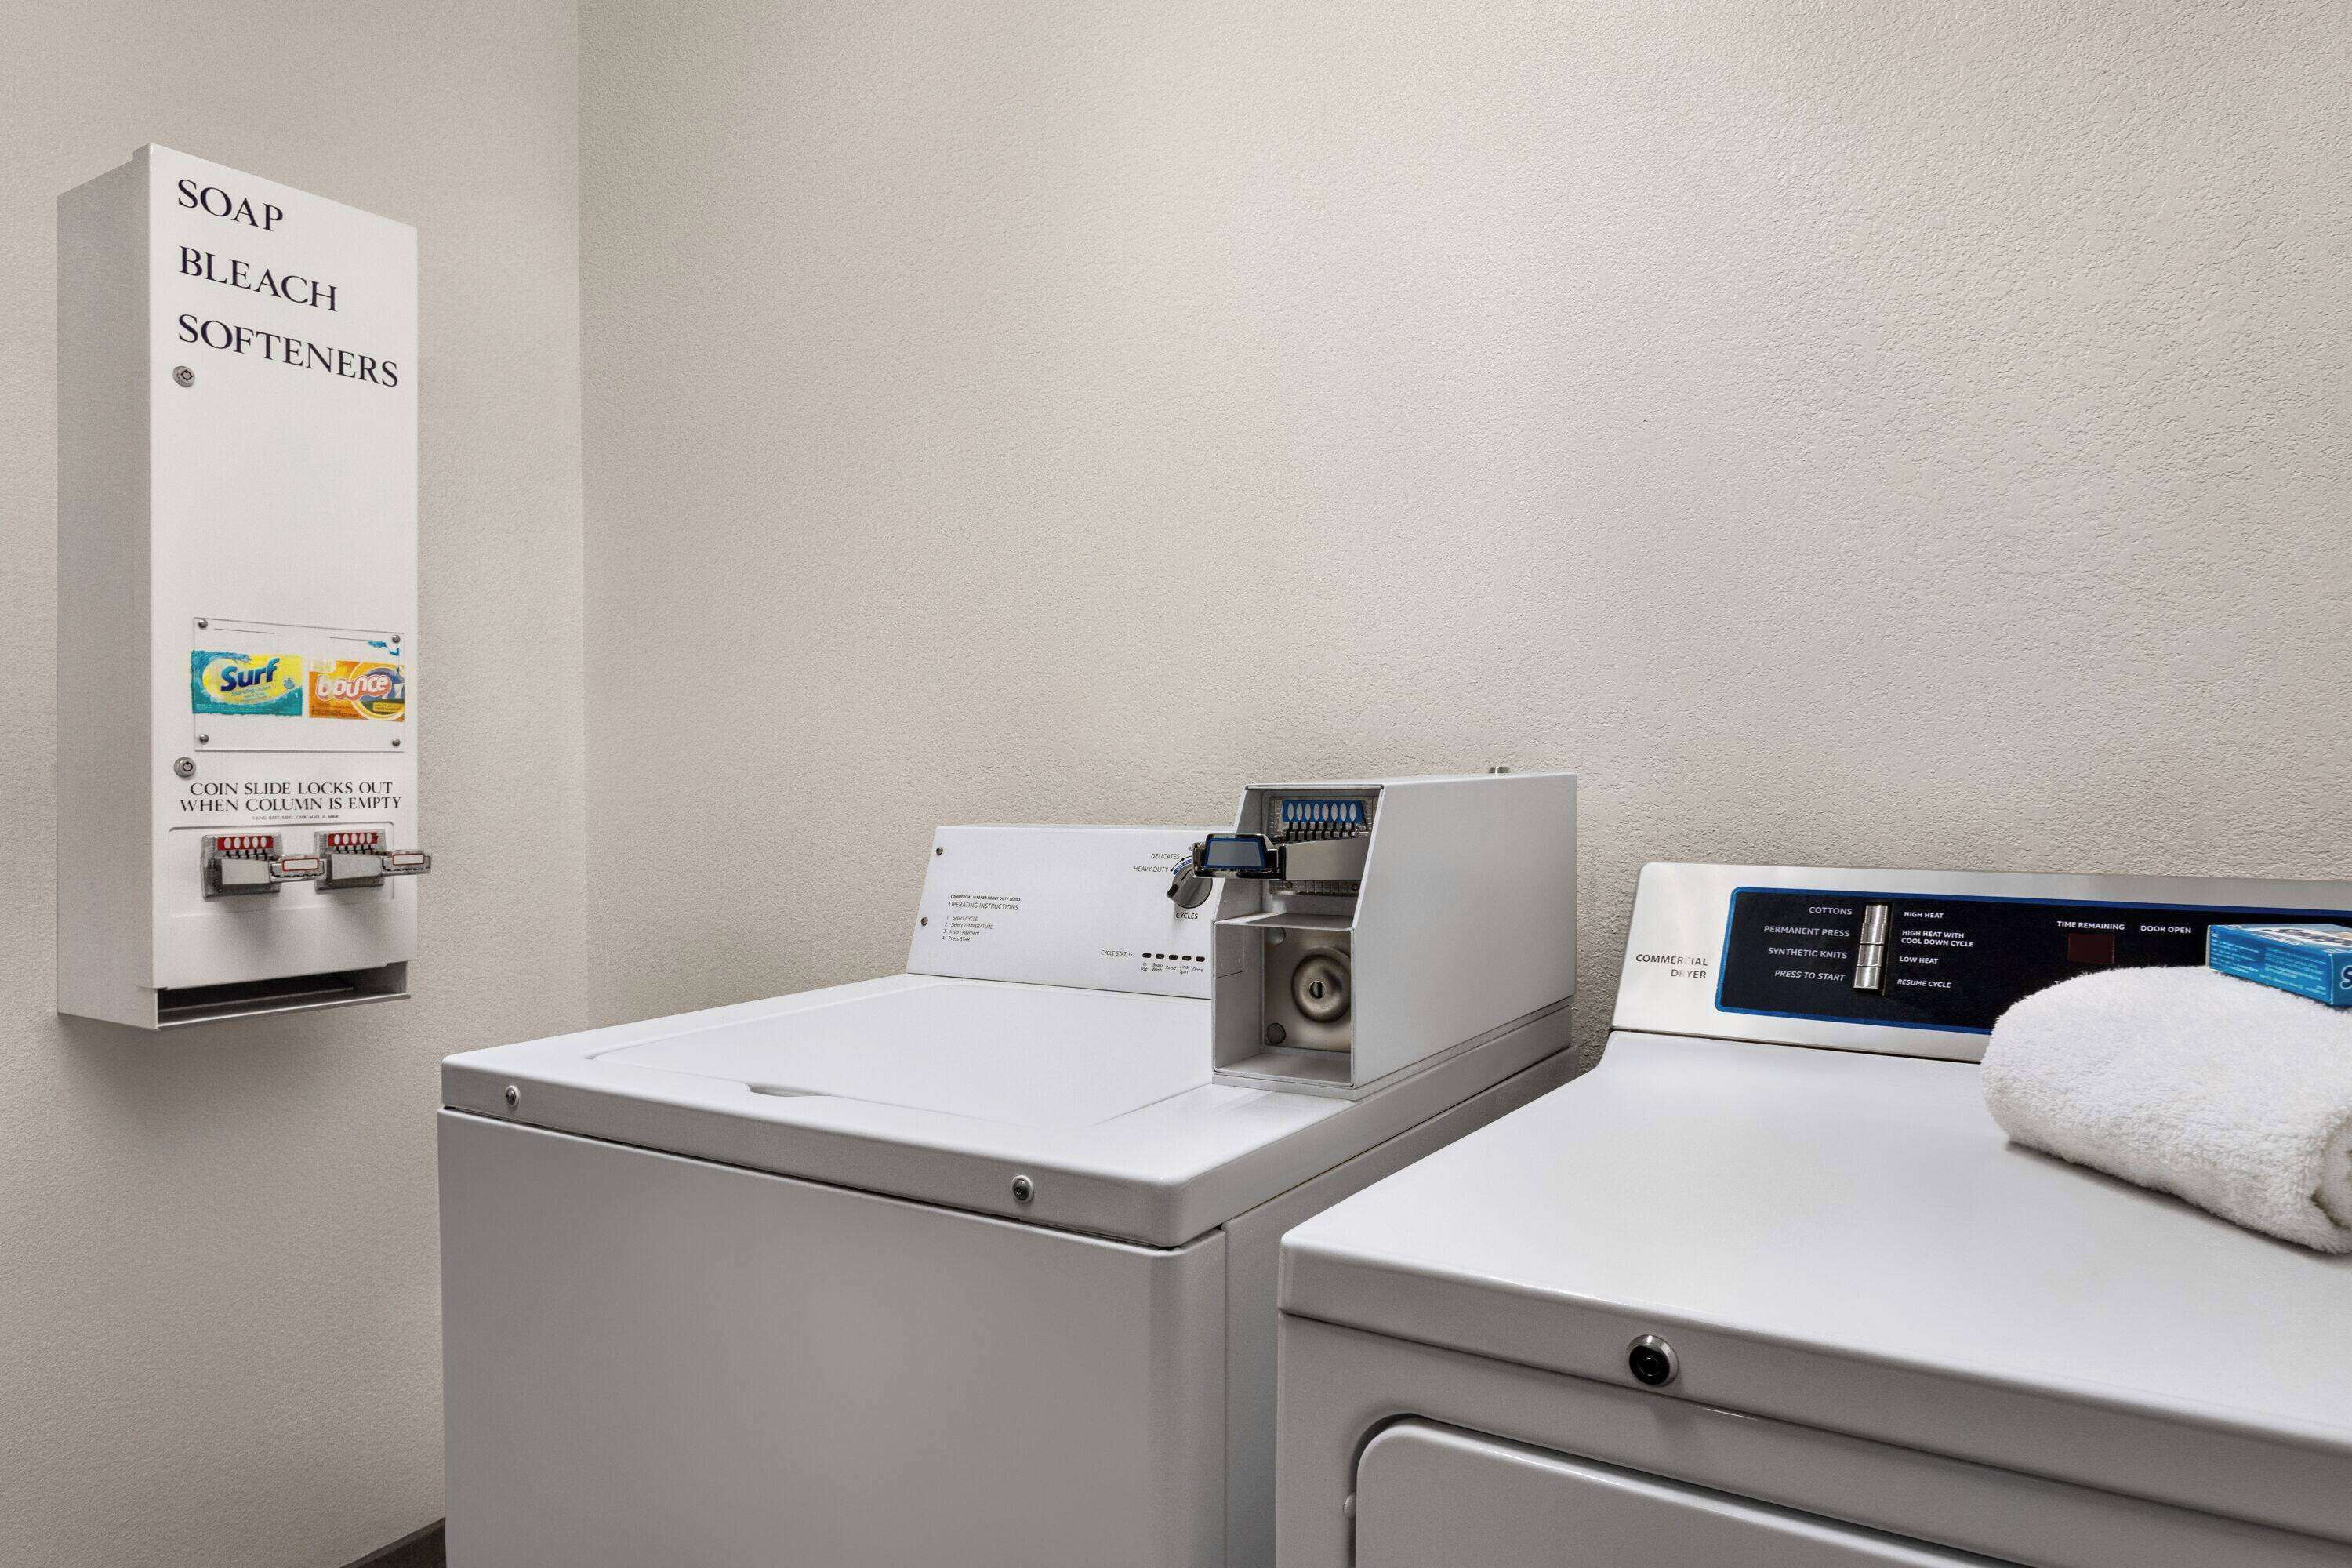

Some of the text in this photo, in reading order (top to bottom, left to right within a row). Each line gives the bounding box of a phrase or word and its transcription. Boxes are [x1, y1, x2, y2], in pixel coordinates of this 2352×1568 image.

[178, 179, 284, 232] SOAP
[179, 245, 338, 313] BLEACH
[178, 314, 398, 387] SOFTENERS
[220, 657, 281, 691] Surf
[316, 673, 392, 702] bounce
[190, 782, 393, 795] COIN SLIDE LOCKS OUT
[180, 797, 401, 811] WHEN COLUMN IS EMPTY
[1809, 906, 1853, 915] COTTONS
[1763, 925, 1850, 937] PERMANENT PRESS
[2078, 921, 2125, 931] REMAINING
[1768, 947, 1848, 959] SYNTHETIC KNITS
[1635, 954, 1708, 966] COMMERIAL
[1774, 970, 1802, 978] PRESS
[1817, 972, 1846, 982] START
